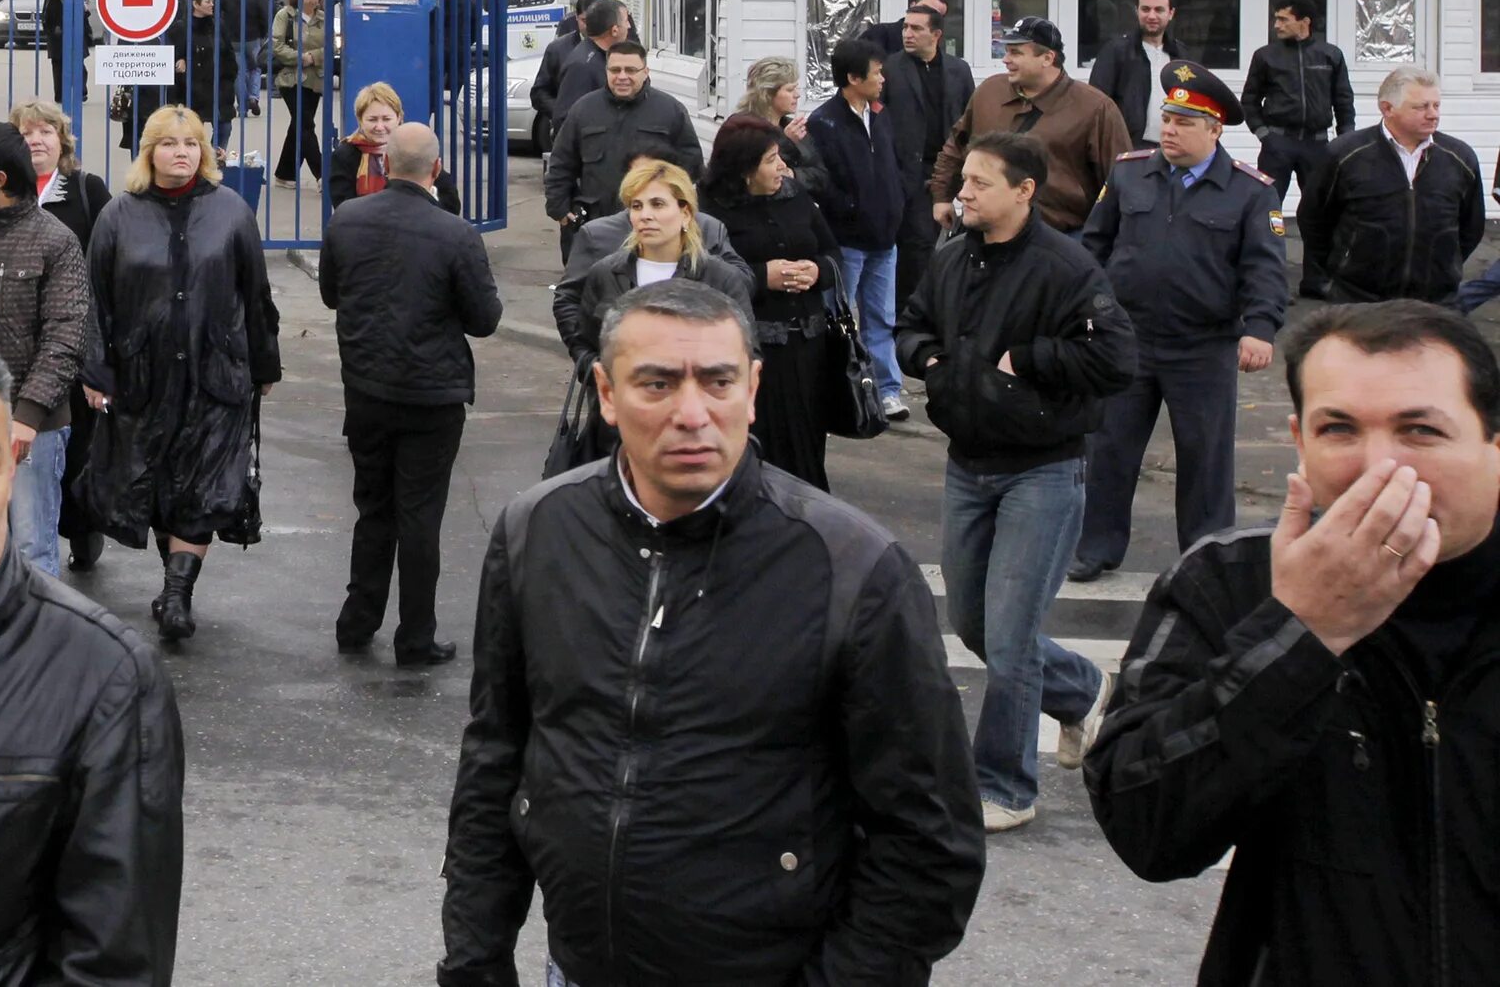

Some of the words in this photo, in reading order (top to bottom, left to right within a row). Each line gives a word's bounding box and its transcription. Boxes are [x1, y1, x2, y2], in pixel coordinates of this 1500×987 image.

[112, 51, 157, 59] движение
[115, 61, 167, 69] территории
[112, 70, 157, 79] ГЦОЛИФК
